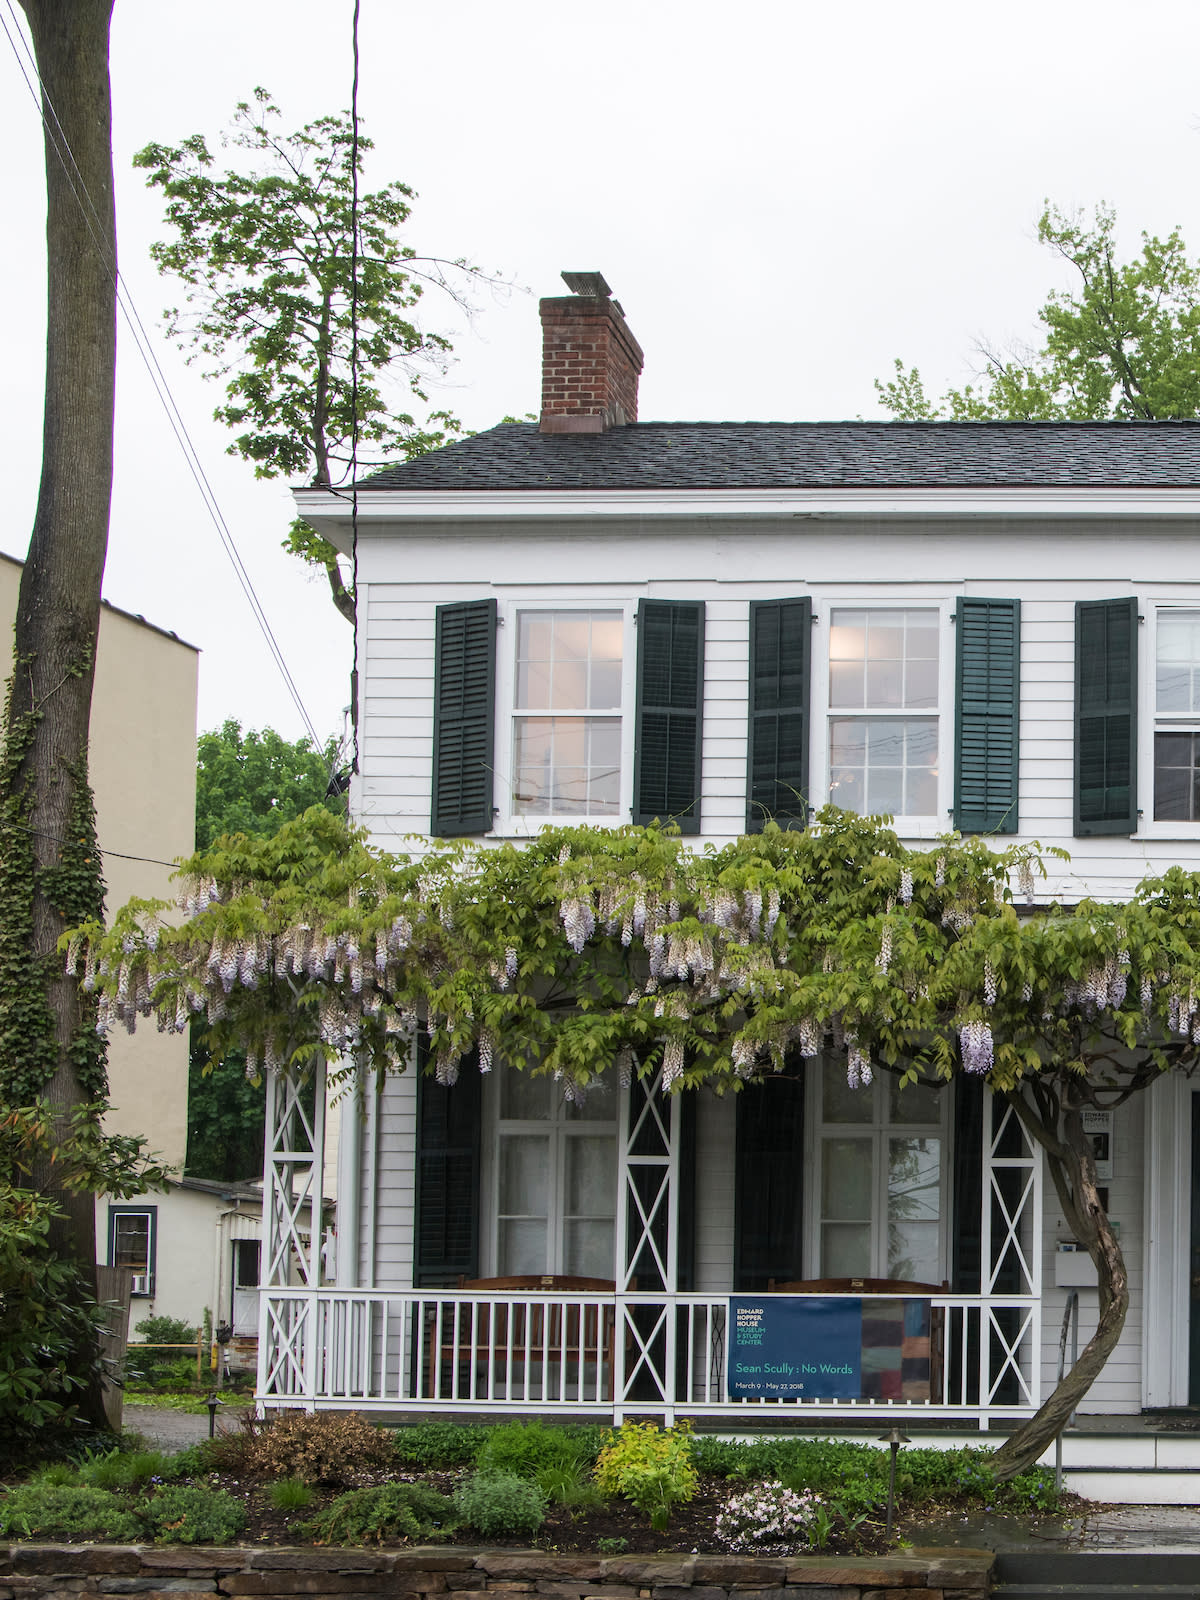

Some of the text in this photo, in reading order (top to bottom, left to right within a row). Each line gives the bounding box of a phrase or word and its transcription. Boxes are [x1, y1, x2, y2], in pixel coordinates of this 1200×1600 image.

[736, 1362, 762, 1372] Sean
[764, 1362, 794, 1376] Scully
[802, 1364, 816, 1374] No
[820, 1364, 852, 1374] Words
